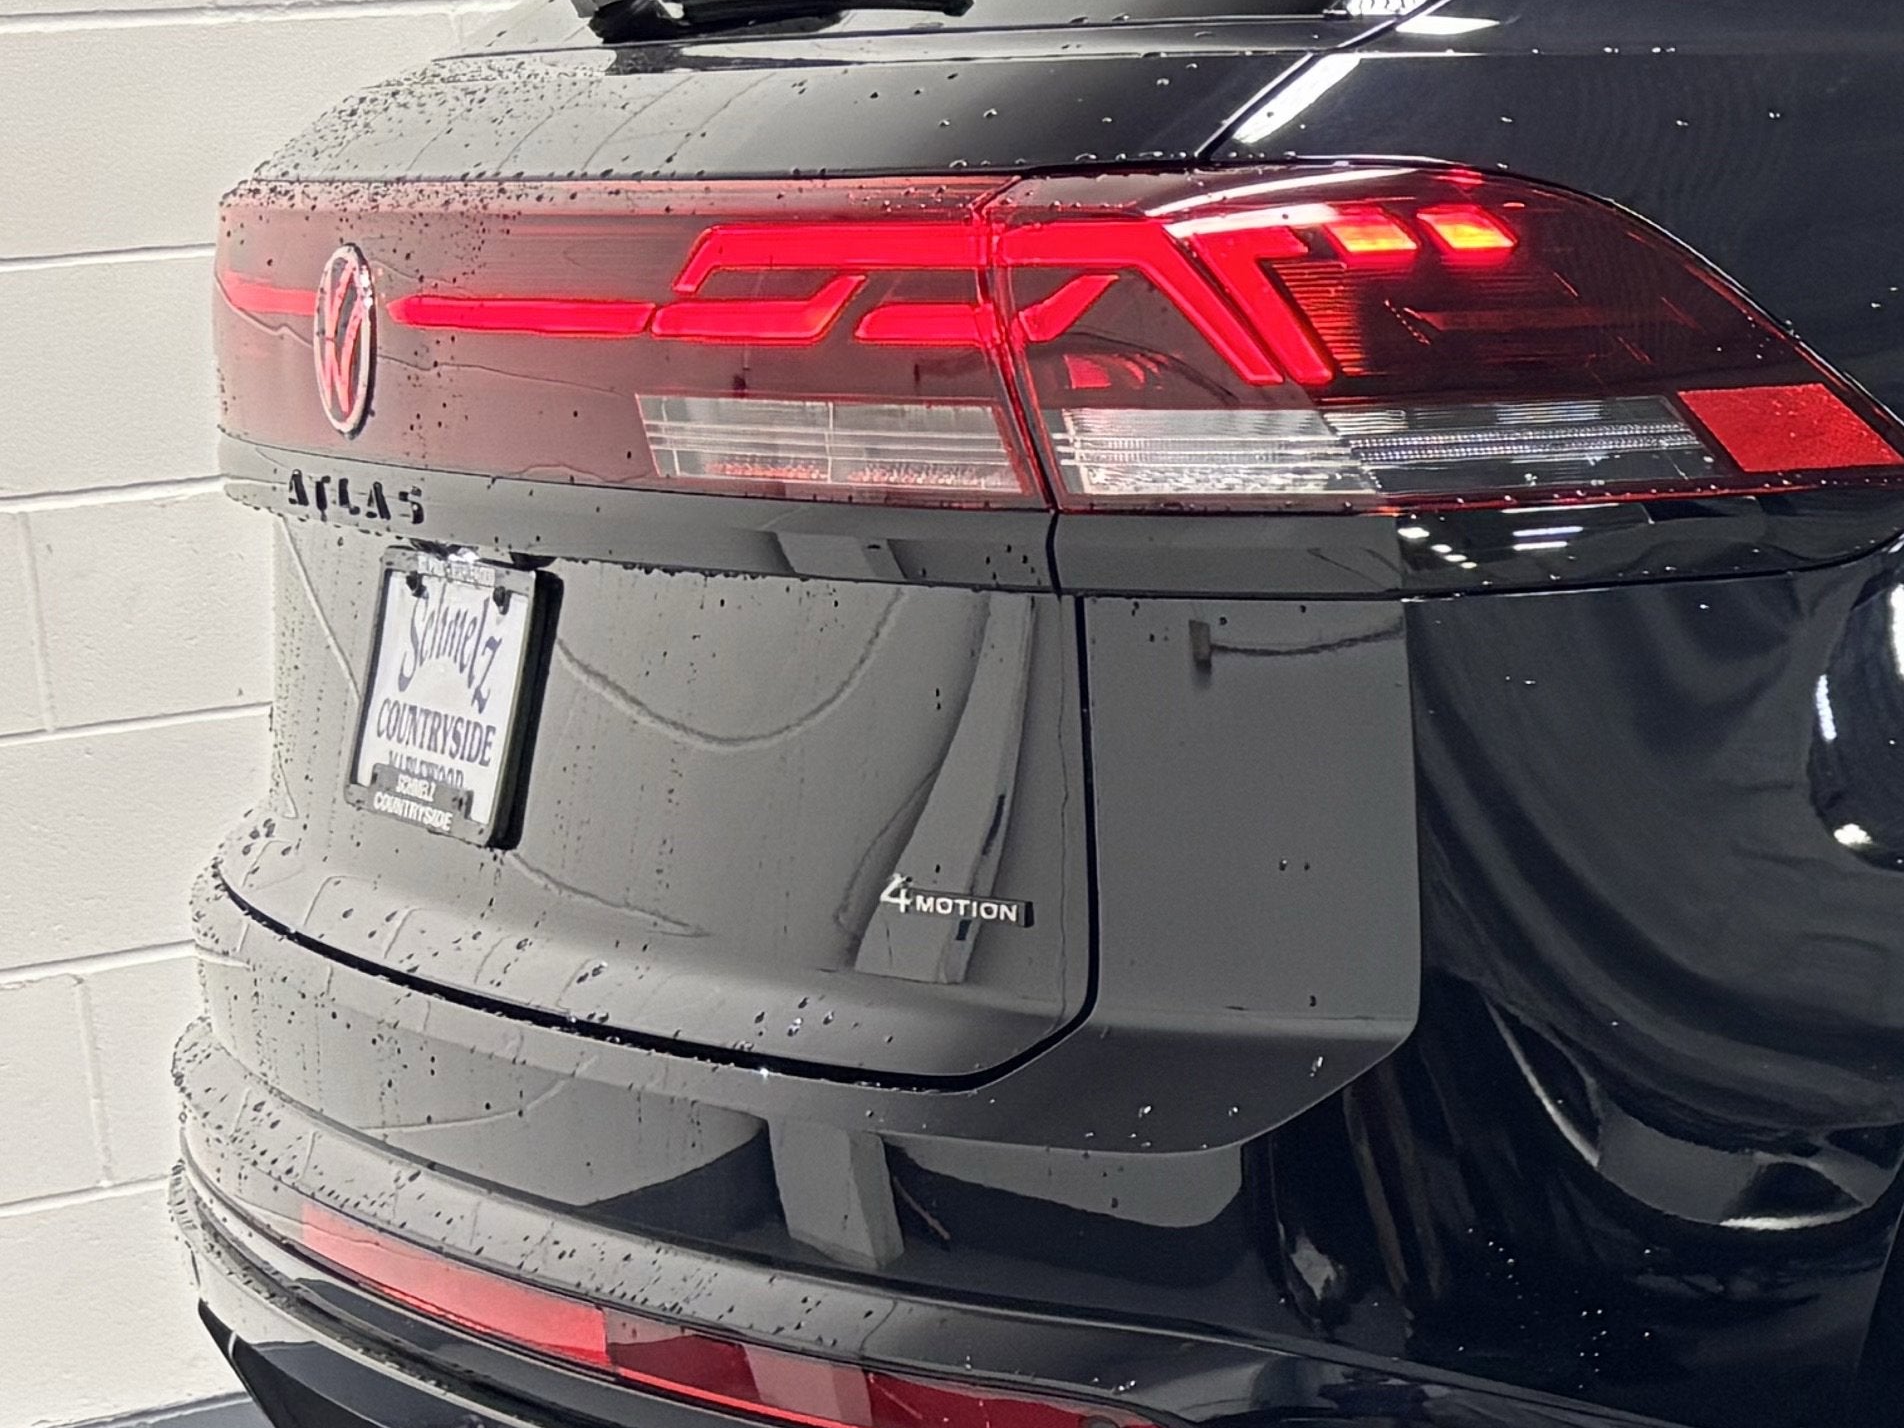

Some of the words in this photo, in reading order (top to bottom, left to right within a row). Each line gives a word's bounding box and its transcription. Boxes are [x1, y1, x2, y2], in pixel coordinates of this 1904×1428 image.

[288, 469, 424, 524] ATLAS
[398, 583, 502, 714] Schmelz
[377, 699, 496, 767] COUNTRYSIDE
[373, 791, 453, 831] COUNTRYSIDE
[880, 872, 1017, 922] 4MOTION
